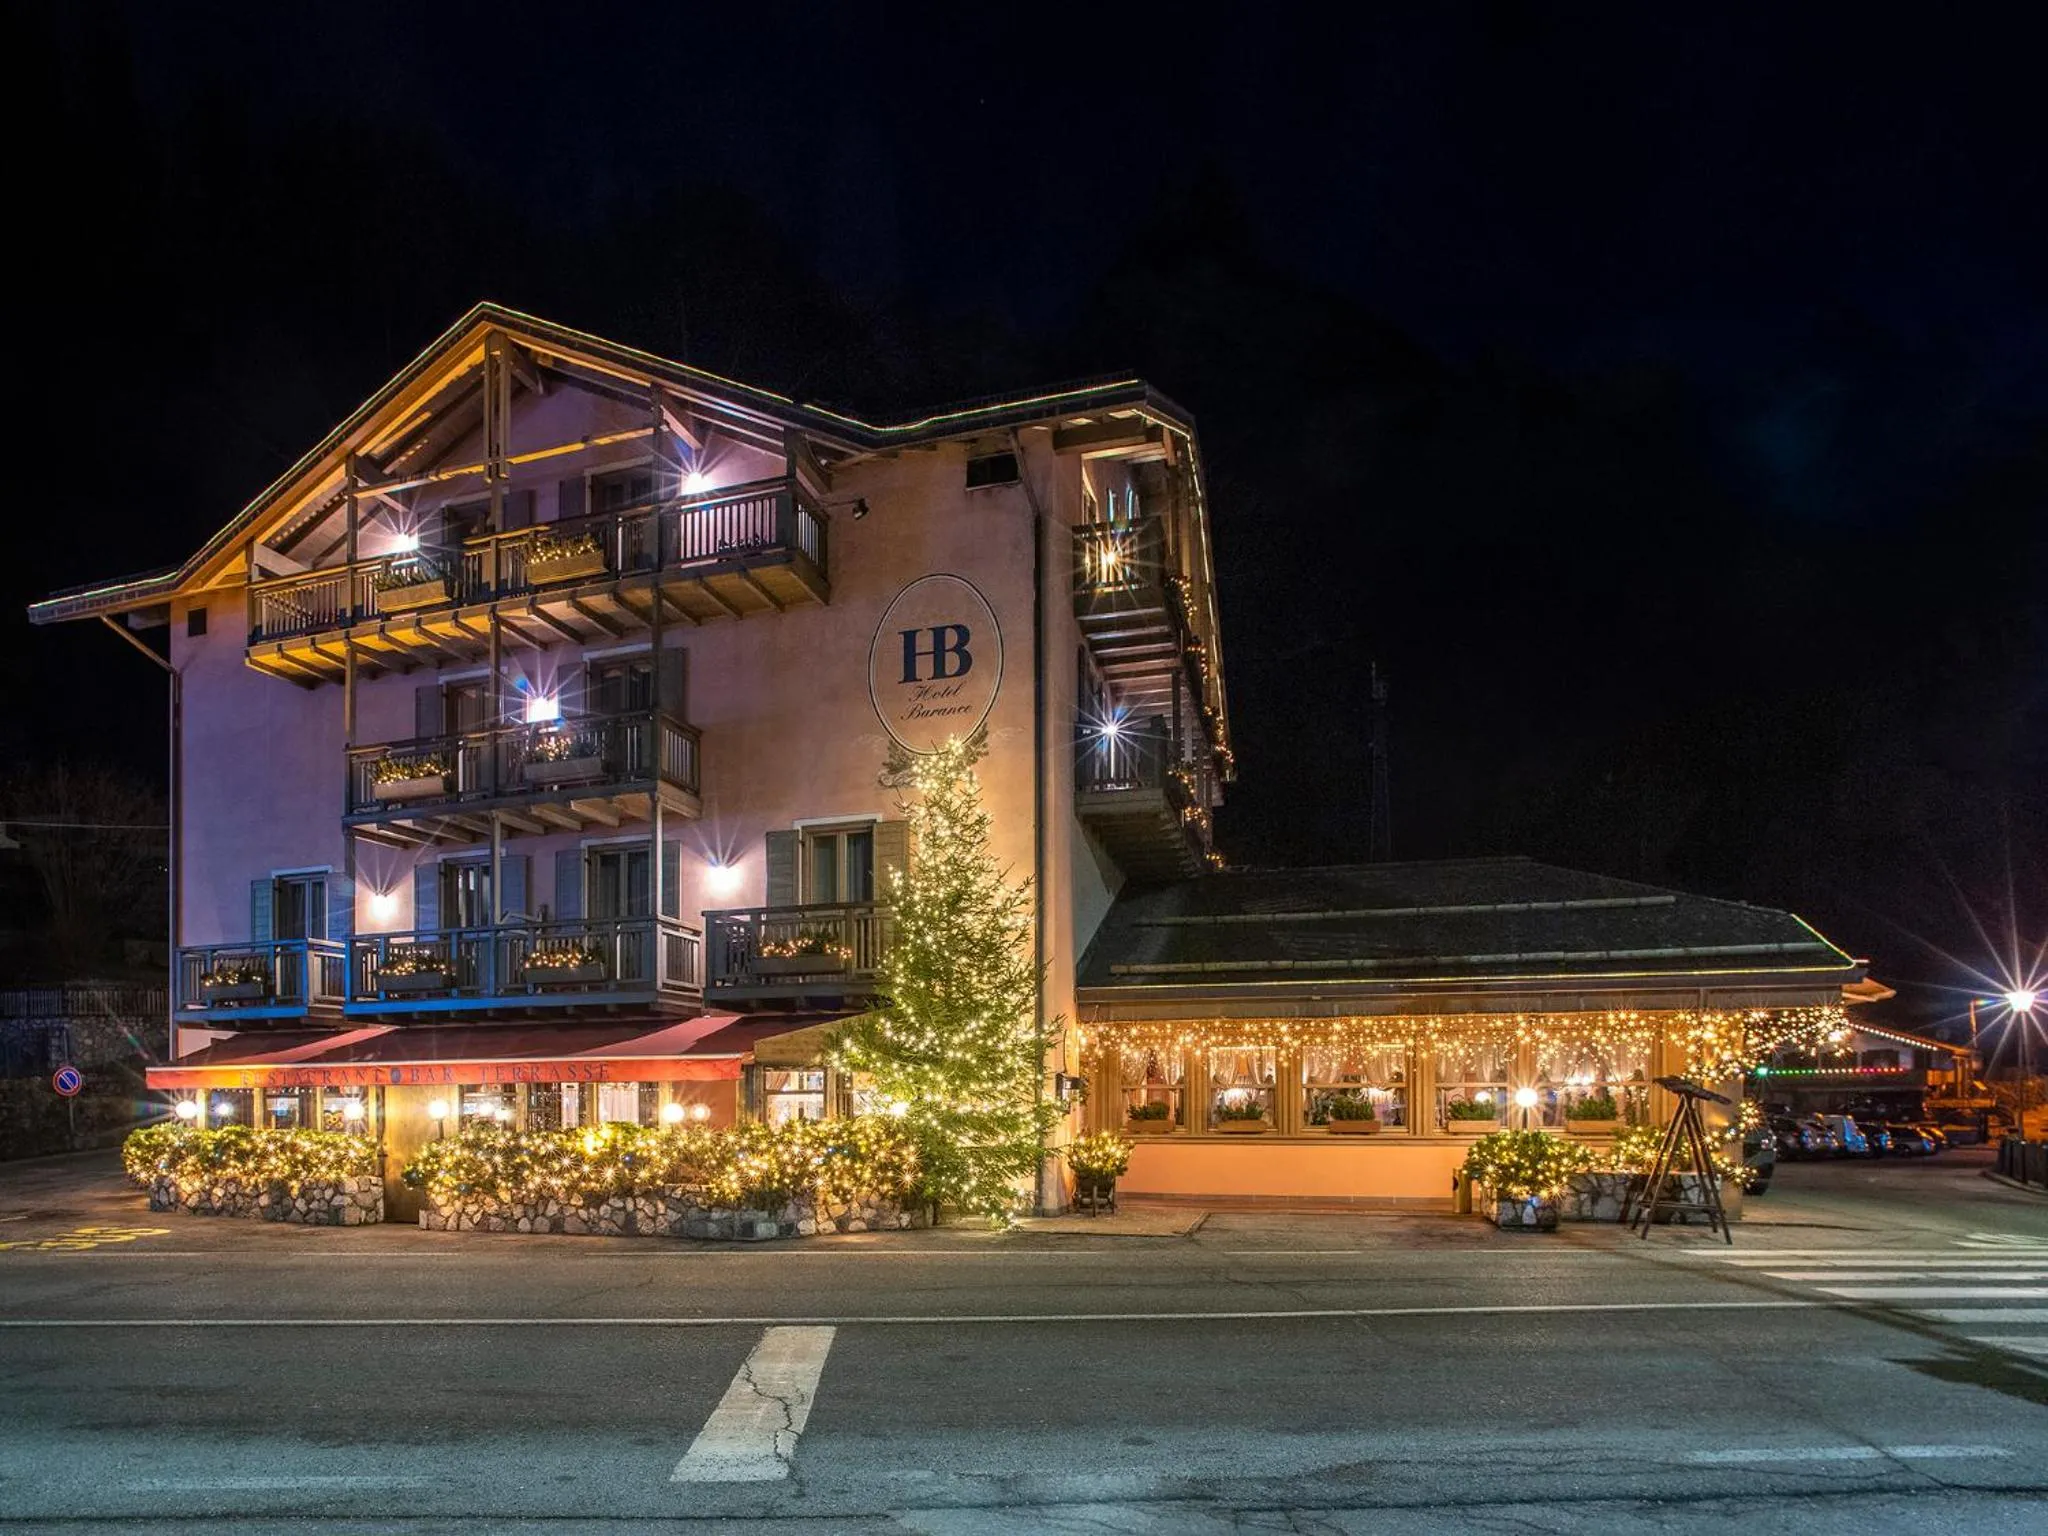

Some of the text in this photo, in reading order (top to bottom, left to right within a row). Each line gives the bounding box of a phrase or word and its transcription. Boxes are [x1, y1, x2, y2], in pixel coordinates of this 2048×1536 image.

[897, 623, 973, 684] HB
[909, 683, 965, 702] Hotel
[411, 1066, 453, 1083] BAR
[480, 1062, 611, 1081] TERRASSE
